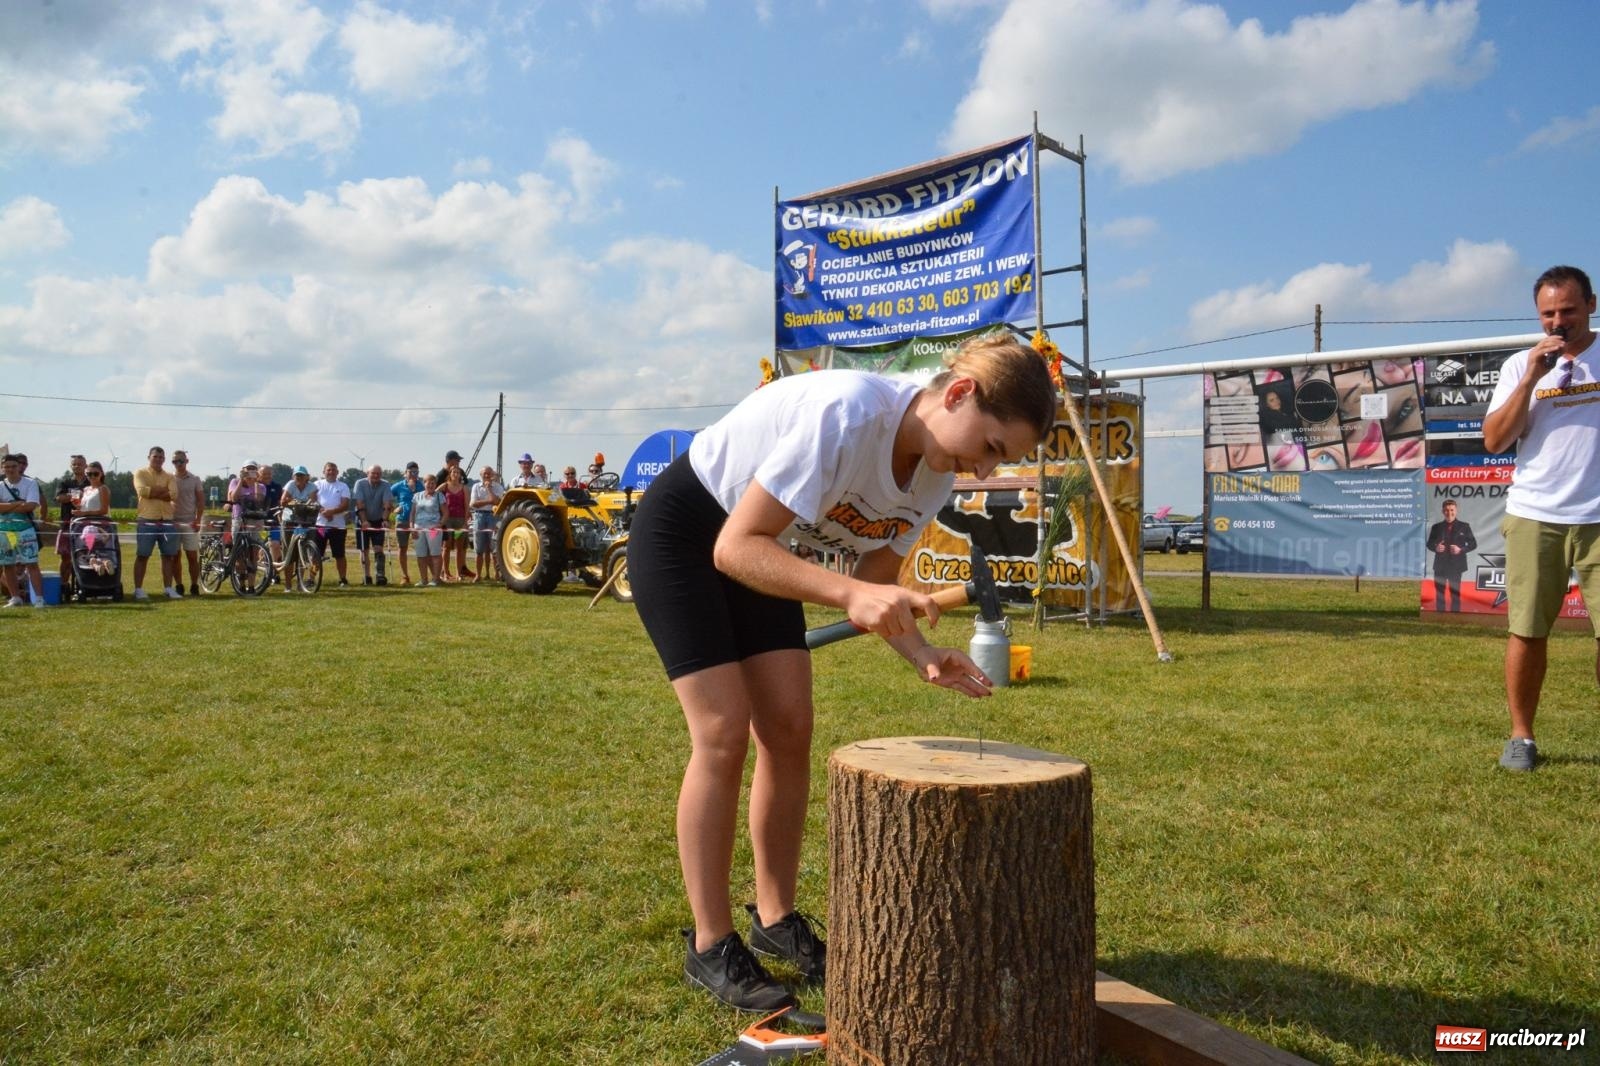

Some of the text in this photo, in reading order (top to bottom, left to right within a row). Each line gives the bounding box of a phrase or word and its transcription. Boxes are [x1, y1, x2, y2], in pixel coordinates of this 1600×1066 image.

[782, 147, 1030, 231] GERARD FITZON
[822, 232, 973, 270] OCIEPLANIE BUDYNKÓW
[821, 246, 984, 286] PRODUKCJA SZTUKATERII
[822, 253, 1030, 301] TYNKI DEKORACYJNE ZEW. I WEW.
[784, 273, 1032, 328] Sławików 32 410 63 30, 603 703 192
[828, 309, 980, 341] www.sztukateria-fitzon.pl
[913, 341, 944, 356] KOŁO
[1465, 370, 1500, 386] MEB
[1441, 390, 1467, 405] NA
[1027, 420, 1134, 462] RMER
[1431, 468, 1490, 480] Garnitury
[1213, 494, 1238, 502] Mariusz
[1434, 485, 1485, 498] MODA
[1233, 520, 1276, 528] 606 454 105
[917, 552, 1093, 586] Grzeorzoic
[1568, 597, 1580, 605] ul.
